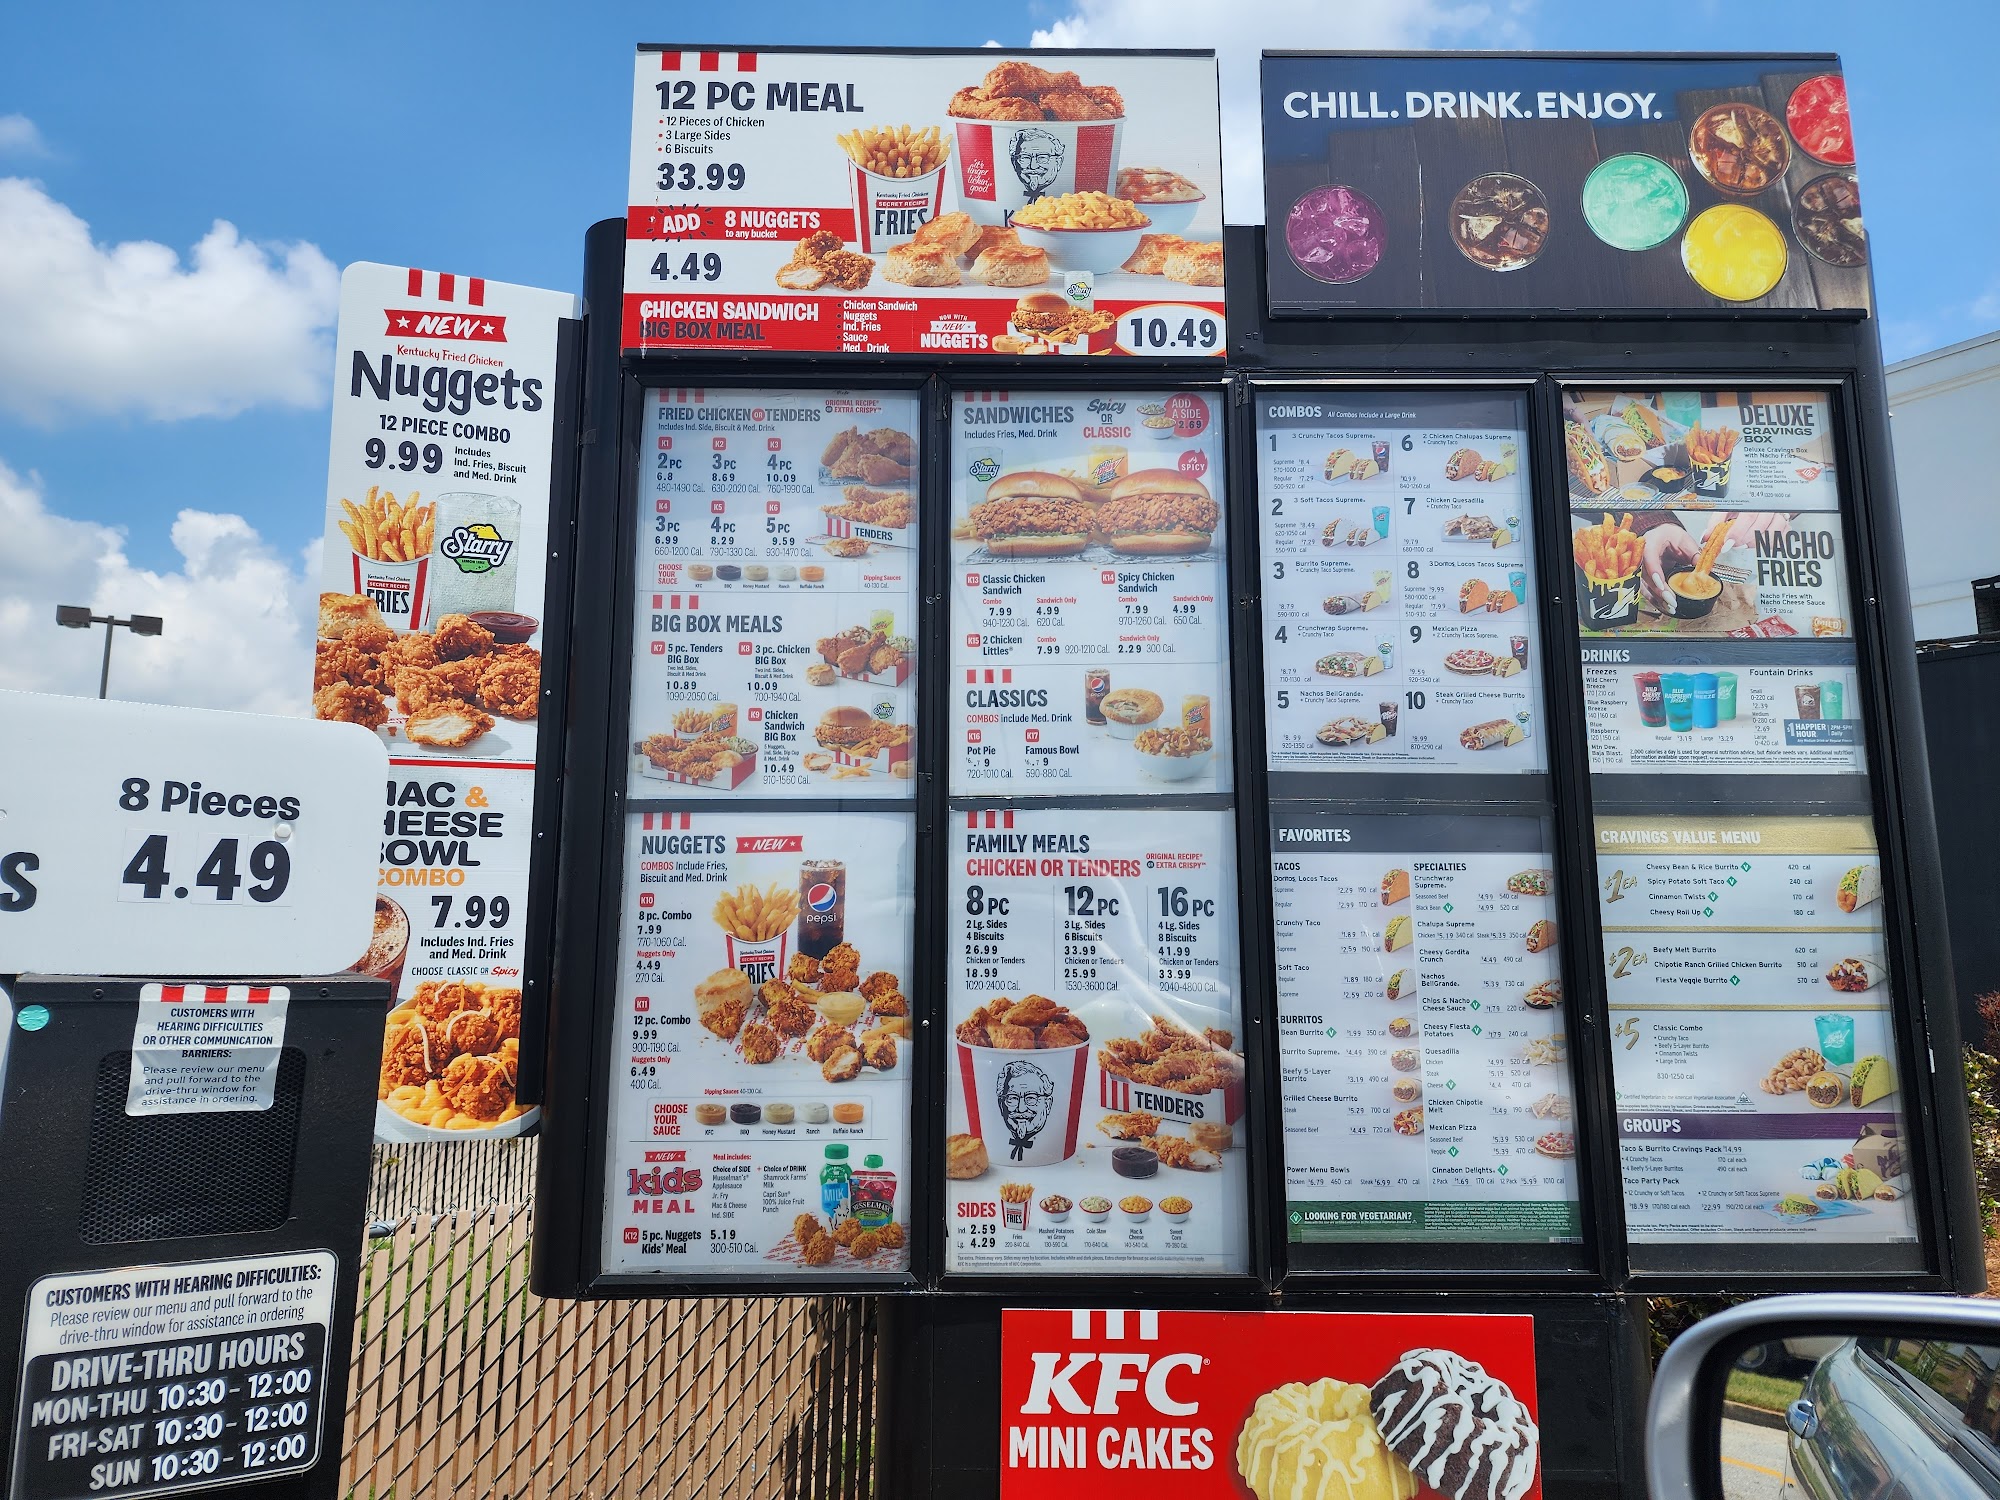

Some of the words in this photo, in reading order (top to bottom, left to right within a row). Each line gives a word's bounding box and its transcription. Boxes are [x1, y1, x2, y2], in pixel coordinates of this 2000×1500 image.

[655, 81, 697, 111] 12
[707, 82, 755, 112] PC
[767, 82, 863, 113] MEAL
[1283, 92, 1399, 119] CHILL.
[1406, 92, 1532, 119] DRINK.
[1537, 92, 1662, 119] ENJOY.
[666, 117, 677, 126] 12
[680, 116, 708, 126] Pieces
[712, 116, 722, 127] of
[725, 117, 765, 128] Chicken
[666, 131, 671, 139] 3
[674, 130, 699, 141] Large
[705, 130, 731, 140] Sides
[666, 144, 672, 153] 6
[674, 144, 713, 154] Biscuits
[657, 163, 746, 190] 33.99
[663, 213, 701, 235] ADD
[725, 212, 737, 228] 8
[741, 211, 820, 229] NUGGETS
[725, 230, 734, 238] to
[736, 231, 750, 239] any
[752, 229, 778, 238] bucket
[651, 253, 722, 281] 4.49
[640, 301, 717, 321] CHICKEN
[723, 302, 819, 321] SANDWICH
[415, 315, 480, 339] NEW
[640, 321, 672, 338] BIG
[675, 322, 713, 339] BOX
[717, 323, 765, 339] MEAL
[1130, 318, 1217, 347] 10.49
[920, 333, 988, 348] NUGGETS
[397, 345, 440, 361] Kentucky
[442, 350, 466, 363] Fried
[469, 353, 504, 367] Chicken
[351, 351, 543, 416] Nuggets
[659, 408, 694, 421] FRIED
[697, 408, 751, 421] CHICKEN
[766, 409, 821, 421] TENDERS
[1087, 399, 1126, 414] Spicy
[1269, 406, 1321, 418] COMBOS
[964, 406, 1074, 424] SANDWICHES
[1739, 405, 1814, 427] DELUXE
[380, 415, 397, 430] 12
[402, 417, 448, 436] PIECE
[453, 424, 510, 443] COMBO
[1083, 427, 1131, 438] CLASSIC
[1742, 428, 1812, 436] CRAVINGS
[365, 438, 443, 474] 9.99
[455, 447, 491, 458] Includes
[454, 458, 470, 467] Ind.
[473, 459, 496, 471] Fries,
[498, 462, 527, 473] Biscuit
[454, 470, 469, 479] and
[472, 471, 492, 481] Med.
[494, 473, 517, 484] Drink
[767, 474, 796, 482] 10.09
[855, 527, 892, 540] TENDERS
[441, 529, 512, 565] Starry
[1754, 530, 1834, 559] NACHO
[1758, 560, 1822, 588] FRIES
[652, 615, 680, 632] BIG
[686, 615, 721, 632] BOX
[726, 615, 782, 632] MEALS
[1581, 650, 1630, 662] DRINKS
[967, 690, 1048, 707] CLASSICS
[765, 711, 798, 719] Chicken
[765, 722, 804, 730] Sandwich
[1796, 730, 1817, 738] HOUR
[765, 733, 780, 741] BIG
[783, 733, 796, 741] Box
[1026, 746, 1058, 754] Famous
[1060, 745, 1079, 754] Bowl
[119, 778, 150, 811] 8
[161, 780, 300, 820] Pieces
[465, 786, 489, 807] &
[1279, 829, 1350, 842] FAVORITES
[1601, 831, 1668, 844] CRAVINGS
[1672, 831, 1717, 844] VALUE
[1722, 831, 1760, 844] MENU
[642, 836, 726, 854] NUGGETS
[753, 839, 787, 850] NEW
[967, 835, 1027, 853] FAMILY
[1033, 835, 1089, 853] MEALS
[380, 839, 481, 866] OWL
[123, 834, 291, 902] 4.49
[967, 859, 1036, 876] CHICKEN
[1041, 860, 1063, 876] OR
[1067, 860, 1141, 877] TENDERS
[1414, 863, 1466, 871] SPECIALTIES
[431, 896, 510, 929] 7.99
[806, 913, 836, 924] pepsi
[420, 936, 464, 948] Includes
[467, 936, 487, 948] Ind.
[489, 936, 514, 948] Fries
[429, 949, 449, 959] and
[452, 948, 476, 960] Med.
[479, 948, 507, 960] Drink
[170, 1007, 226, 1019] CUSTOMERS
[229, 1007, 254, 1018] WITH
[157, 1021, 200, 1033] HEARING
[203, 1021, 263, 1032] DIFFICULTIES
[143, 1036, 154, 1046] OR
[157, 1036, 191, 1046] OTHER
[195, 1035, 273, 1046] COMMUNICATION
[182, 1049, 232, 1058] BARRIERS:
[654, 1104, 688, 1113] CHOOSE
[1134, 1091, 1204, 1118] TENDERS
[1623, 1119, 1681, 1133] GROUPS
[627, 1166, 703, 1196] kids
[634, 1200, 695, 1213] MEAL
[957, 1203, 996, 1217] SIDES
[1304, 1212, 1339, 1220] LOOKING
[1341, 1212, 1357, 1220] FOR
[1360, 1212, 1412, 1221] VEGETARIAN?
[970, 1238, 996, 1248] 4.29
[46, 1283, 130, 1306] CUSTOMERS
[135, 1280, 170, 1298] WITH
[174, 1274, 232, 1294] HEARING
[236, 1265, 321, 1287] DIFFICULTIES:
[51, 1342, 212, 1391] DRIVE-THRU
[218, 1332, 305, 1370] HOURS
[1020, 1353, 1203, 1416] KFC
[31, 1388, 147, 1427] MON-THU
[159, 1379, 226, 1411] 10:30
[248, 1369, 311, 1398] 12:00
[48, 1423, 144, 1461] FRI-SAT
[155, 1413, 222, 1445] 10:30
[245, 1402, 307, 1432] 12:00
[1009, 1427, 1087, 1468] MINI
[1098, 1427, 1214, 1470] CAKES
[89, 1458, 140, 1490] SUN
[152, 1445, 219, 1481] 10:30
[241, 1435, 305, 1468] 12:00
